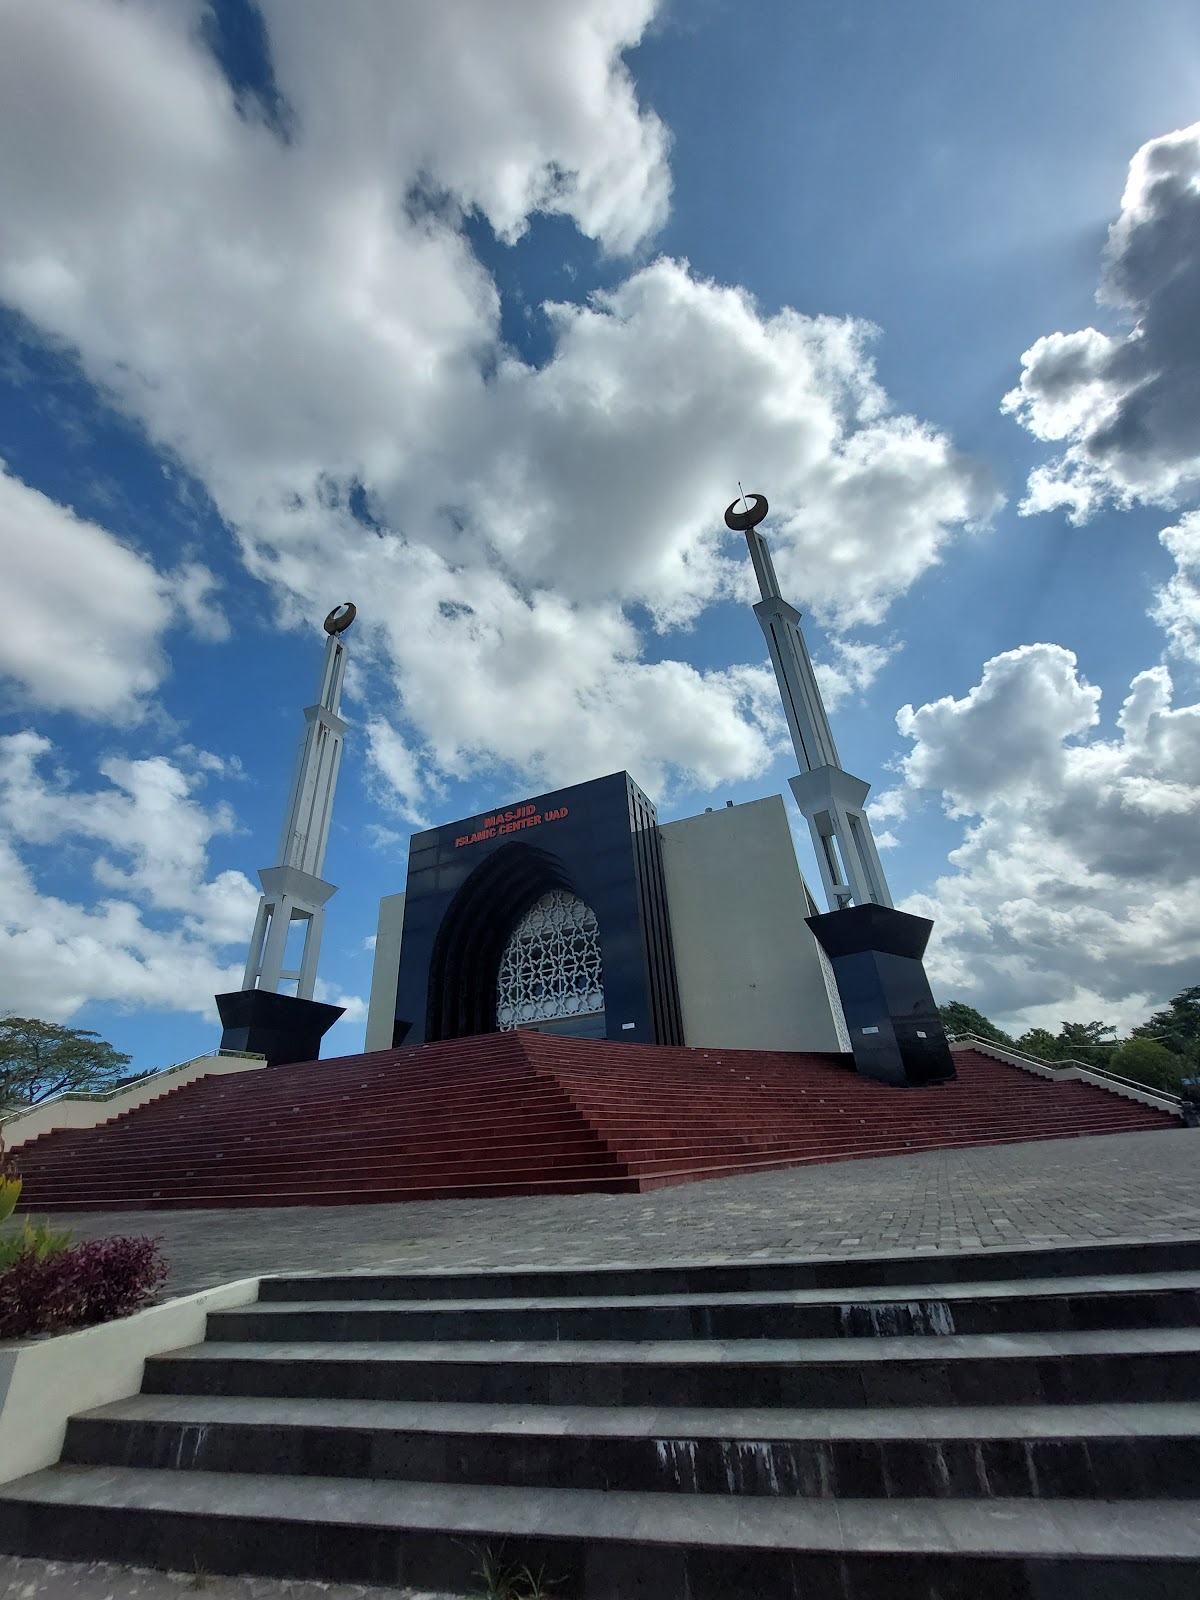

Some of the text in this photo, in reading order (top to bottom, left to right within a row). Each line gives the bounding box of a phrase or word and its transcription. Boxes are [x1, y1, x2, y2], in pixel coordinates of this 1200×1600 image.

[455, 807, 569, 848] ISLAMIC CENTER UAD
[484, 804, 536, 828] MASJID
